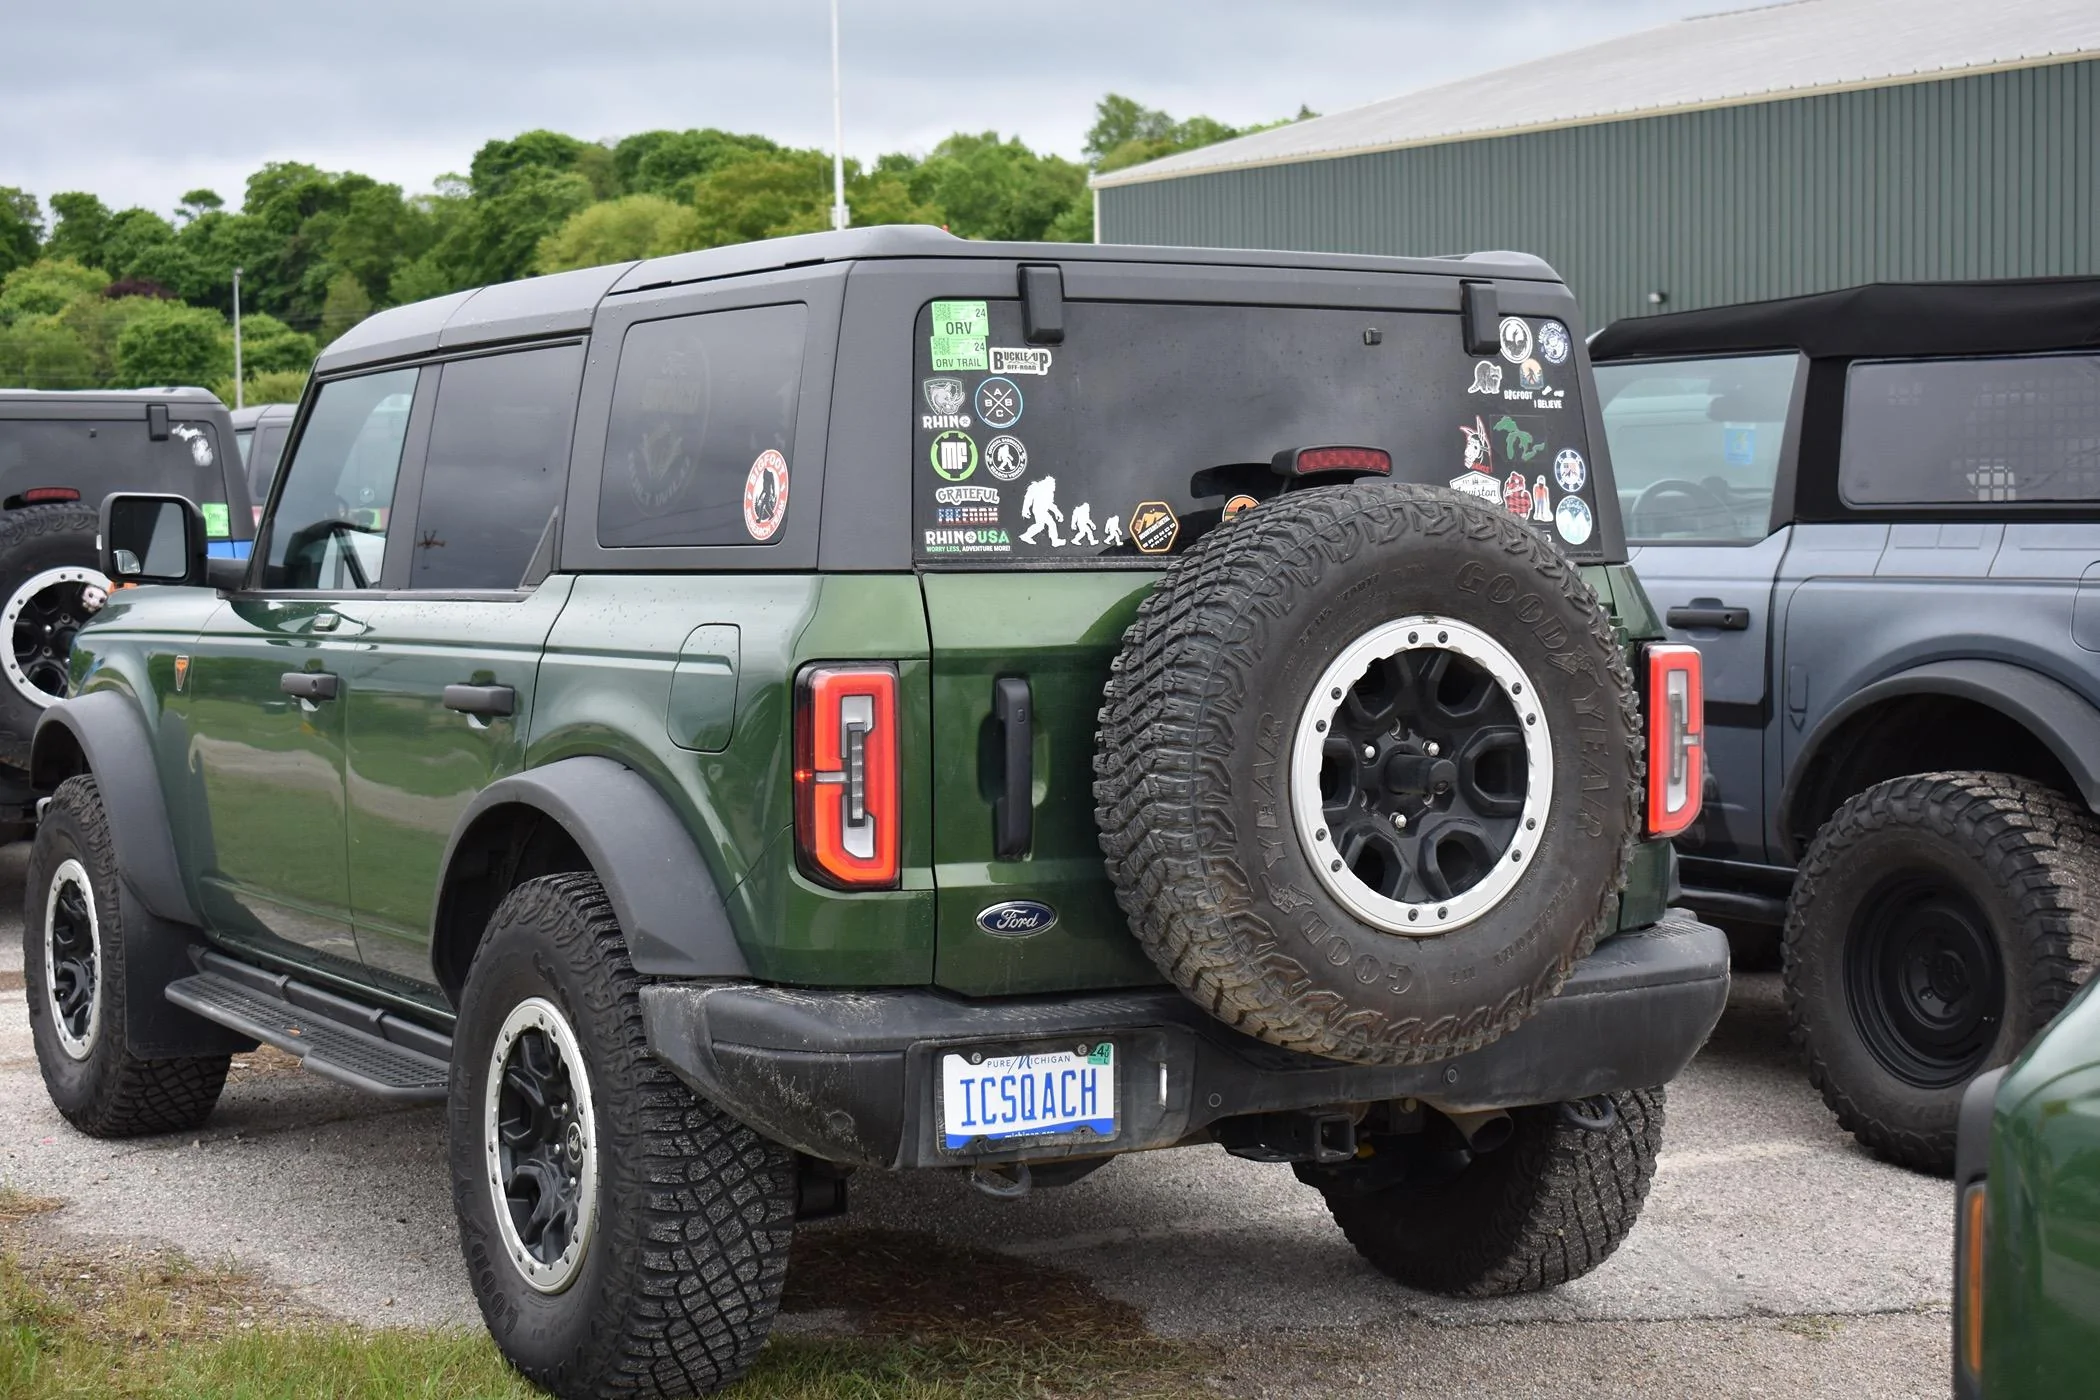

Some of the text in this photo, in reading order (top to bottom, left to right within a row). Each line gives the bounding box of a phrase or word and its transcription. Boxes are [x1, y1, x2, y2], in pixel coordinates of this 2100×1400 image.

[975, 308, 986, 318] 24
[945, 321, 972, 335] ORV
[974, 342, 985, 352] 24
[936, 358, 982, 368] ORV TRAIL
[1537, 399, 1562, 408] BELIEVE
[922, 415, 971, 429] RHINO
[748, 453, 785, 485] BIGFOOT
[937, 487, 999, 503] GRATEFUL
[926, 545, 945, 553] WORRY
[996, 908, 1041, 929] Ford
[987, 1054, 1071, 1070] PURE MICHIGAN
[959, 1068, 1098, 1127] ICSQACH
[1004, 1130, 1055, 1138] michiganorg
